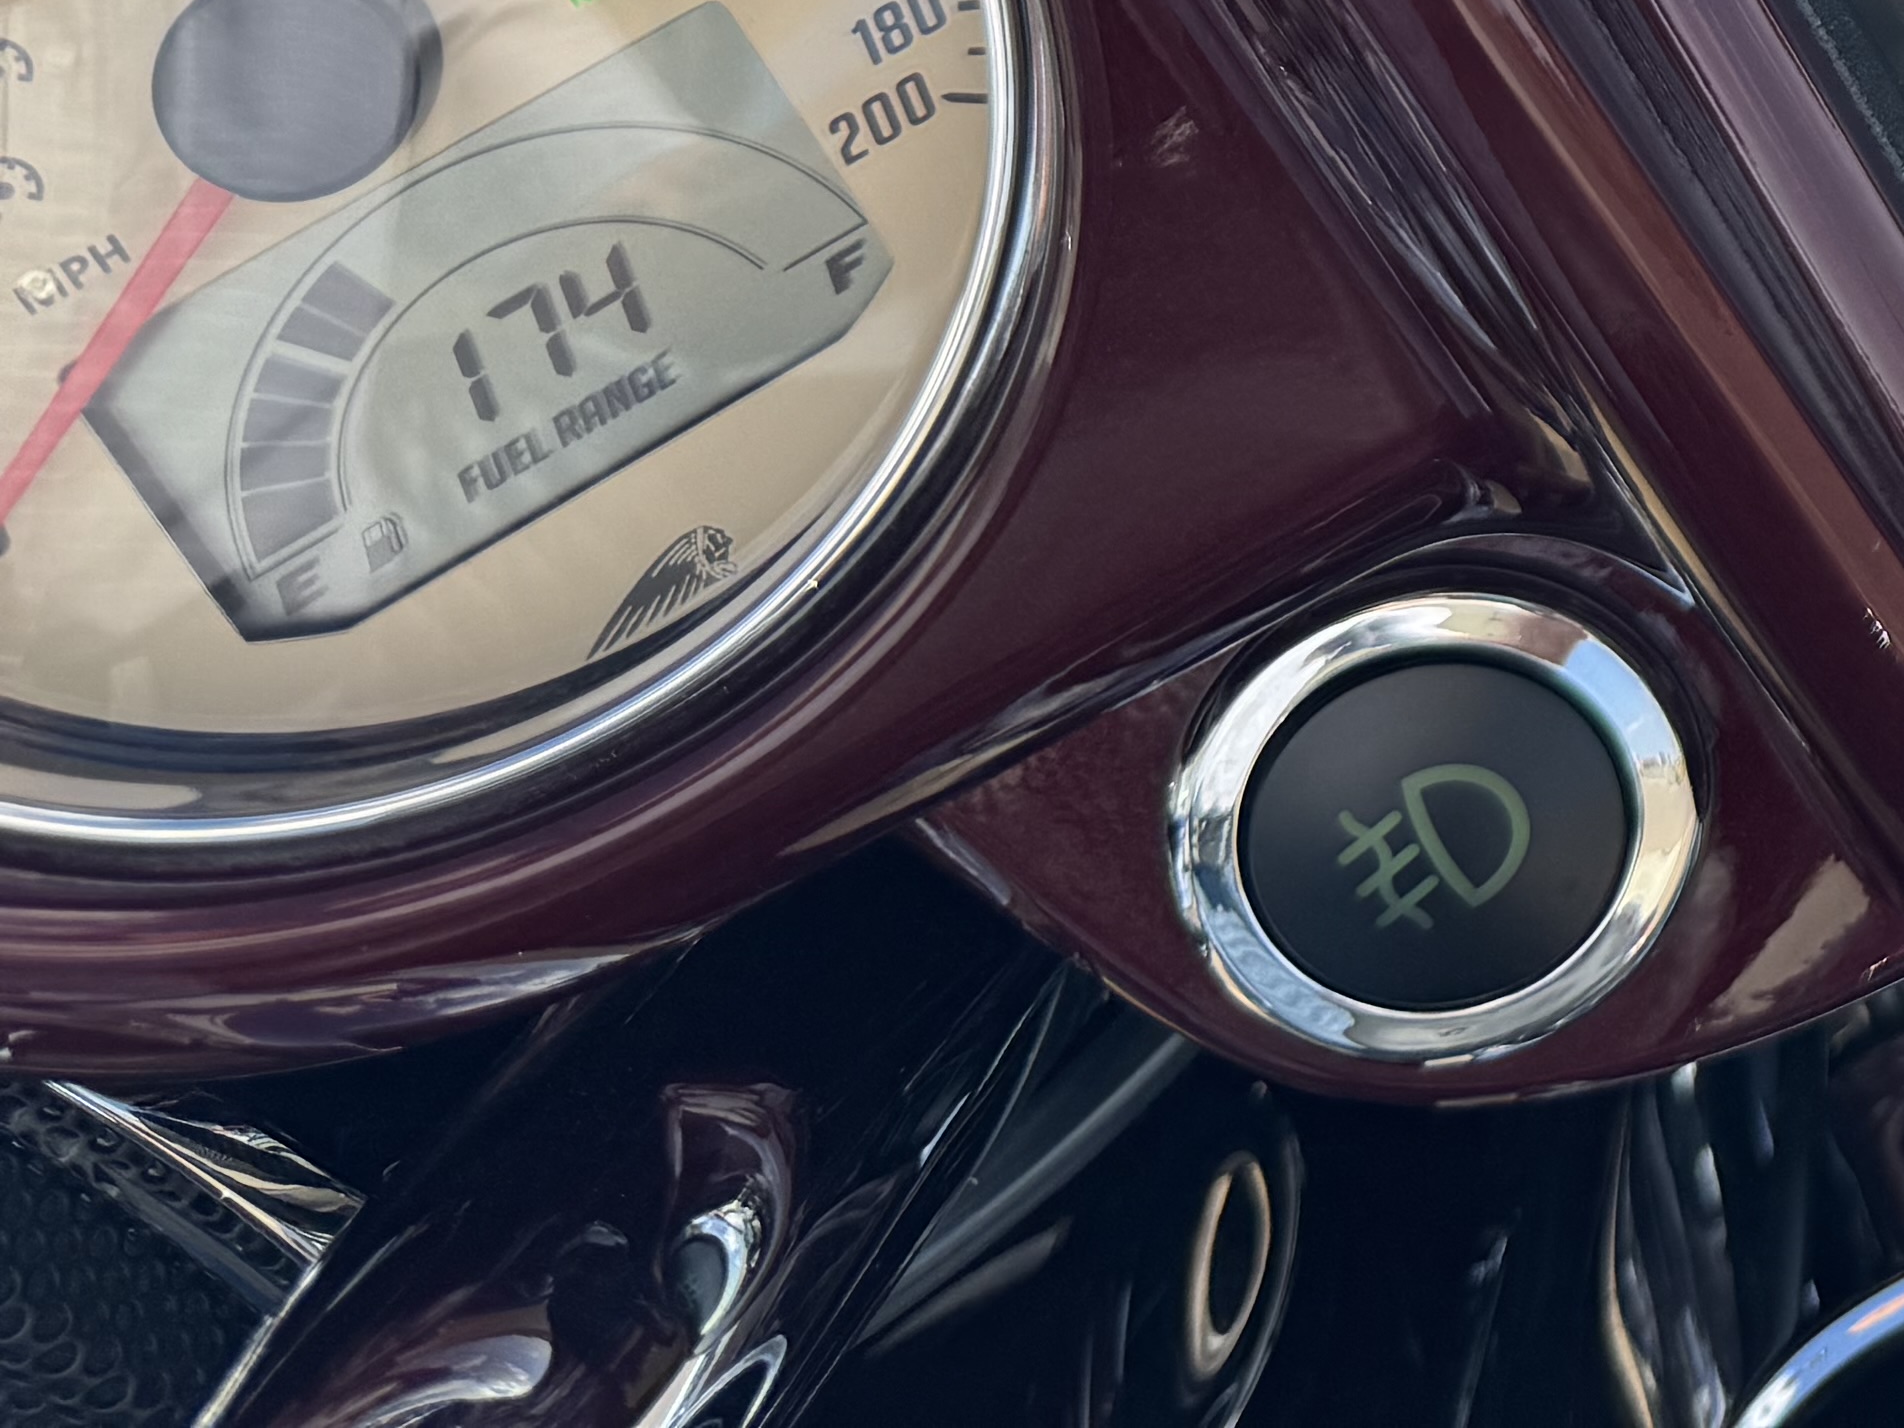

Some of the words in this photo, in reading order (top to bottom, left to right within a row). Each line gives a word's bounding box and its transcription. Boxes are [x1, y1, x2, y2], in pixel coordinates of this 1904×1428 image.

[827, 71, 936, 164] 200
[823, 239, 869, 293] F
[453, 240, 653, 422] 174
[455, 435, 550, 504] FUEL
[552, 351, 683, 448] RANGE
[273, 559, 331, 615] E
